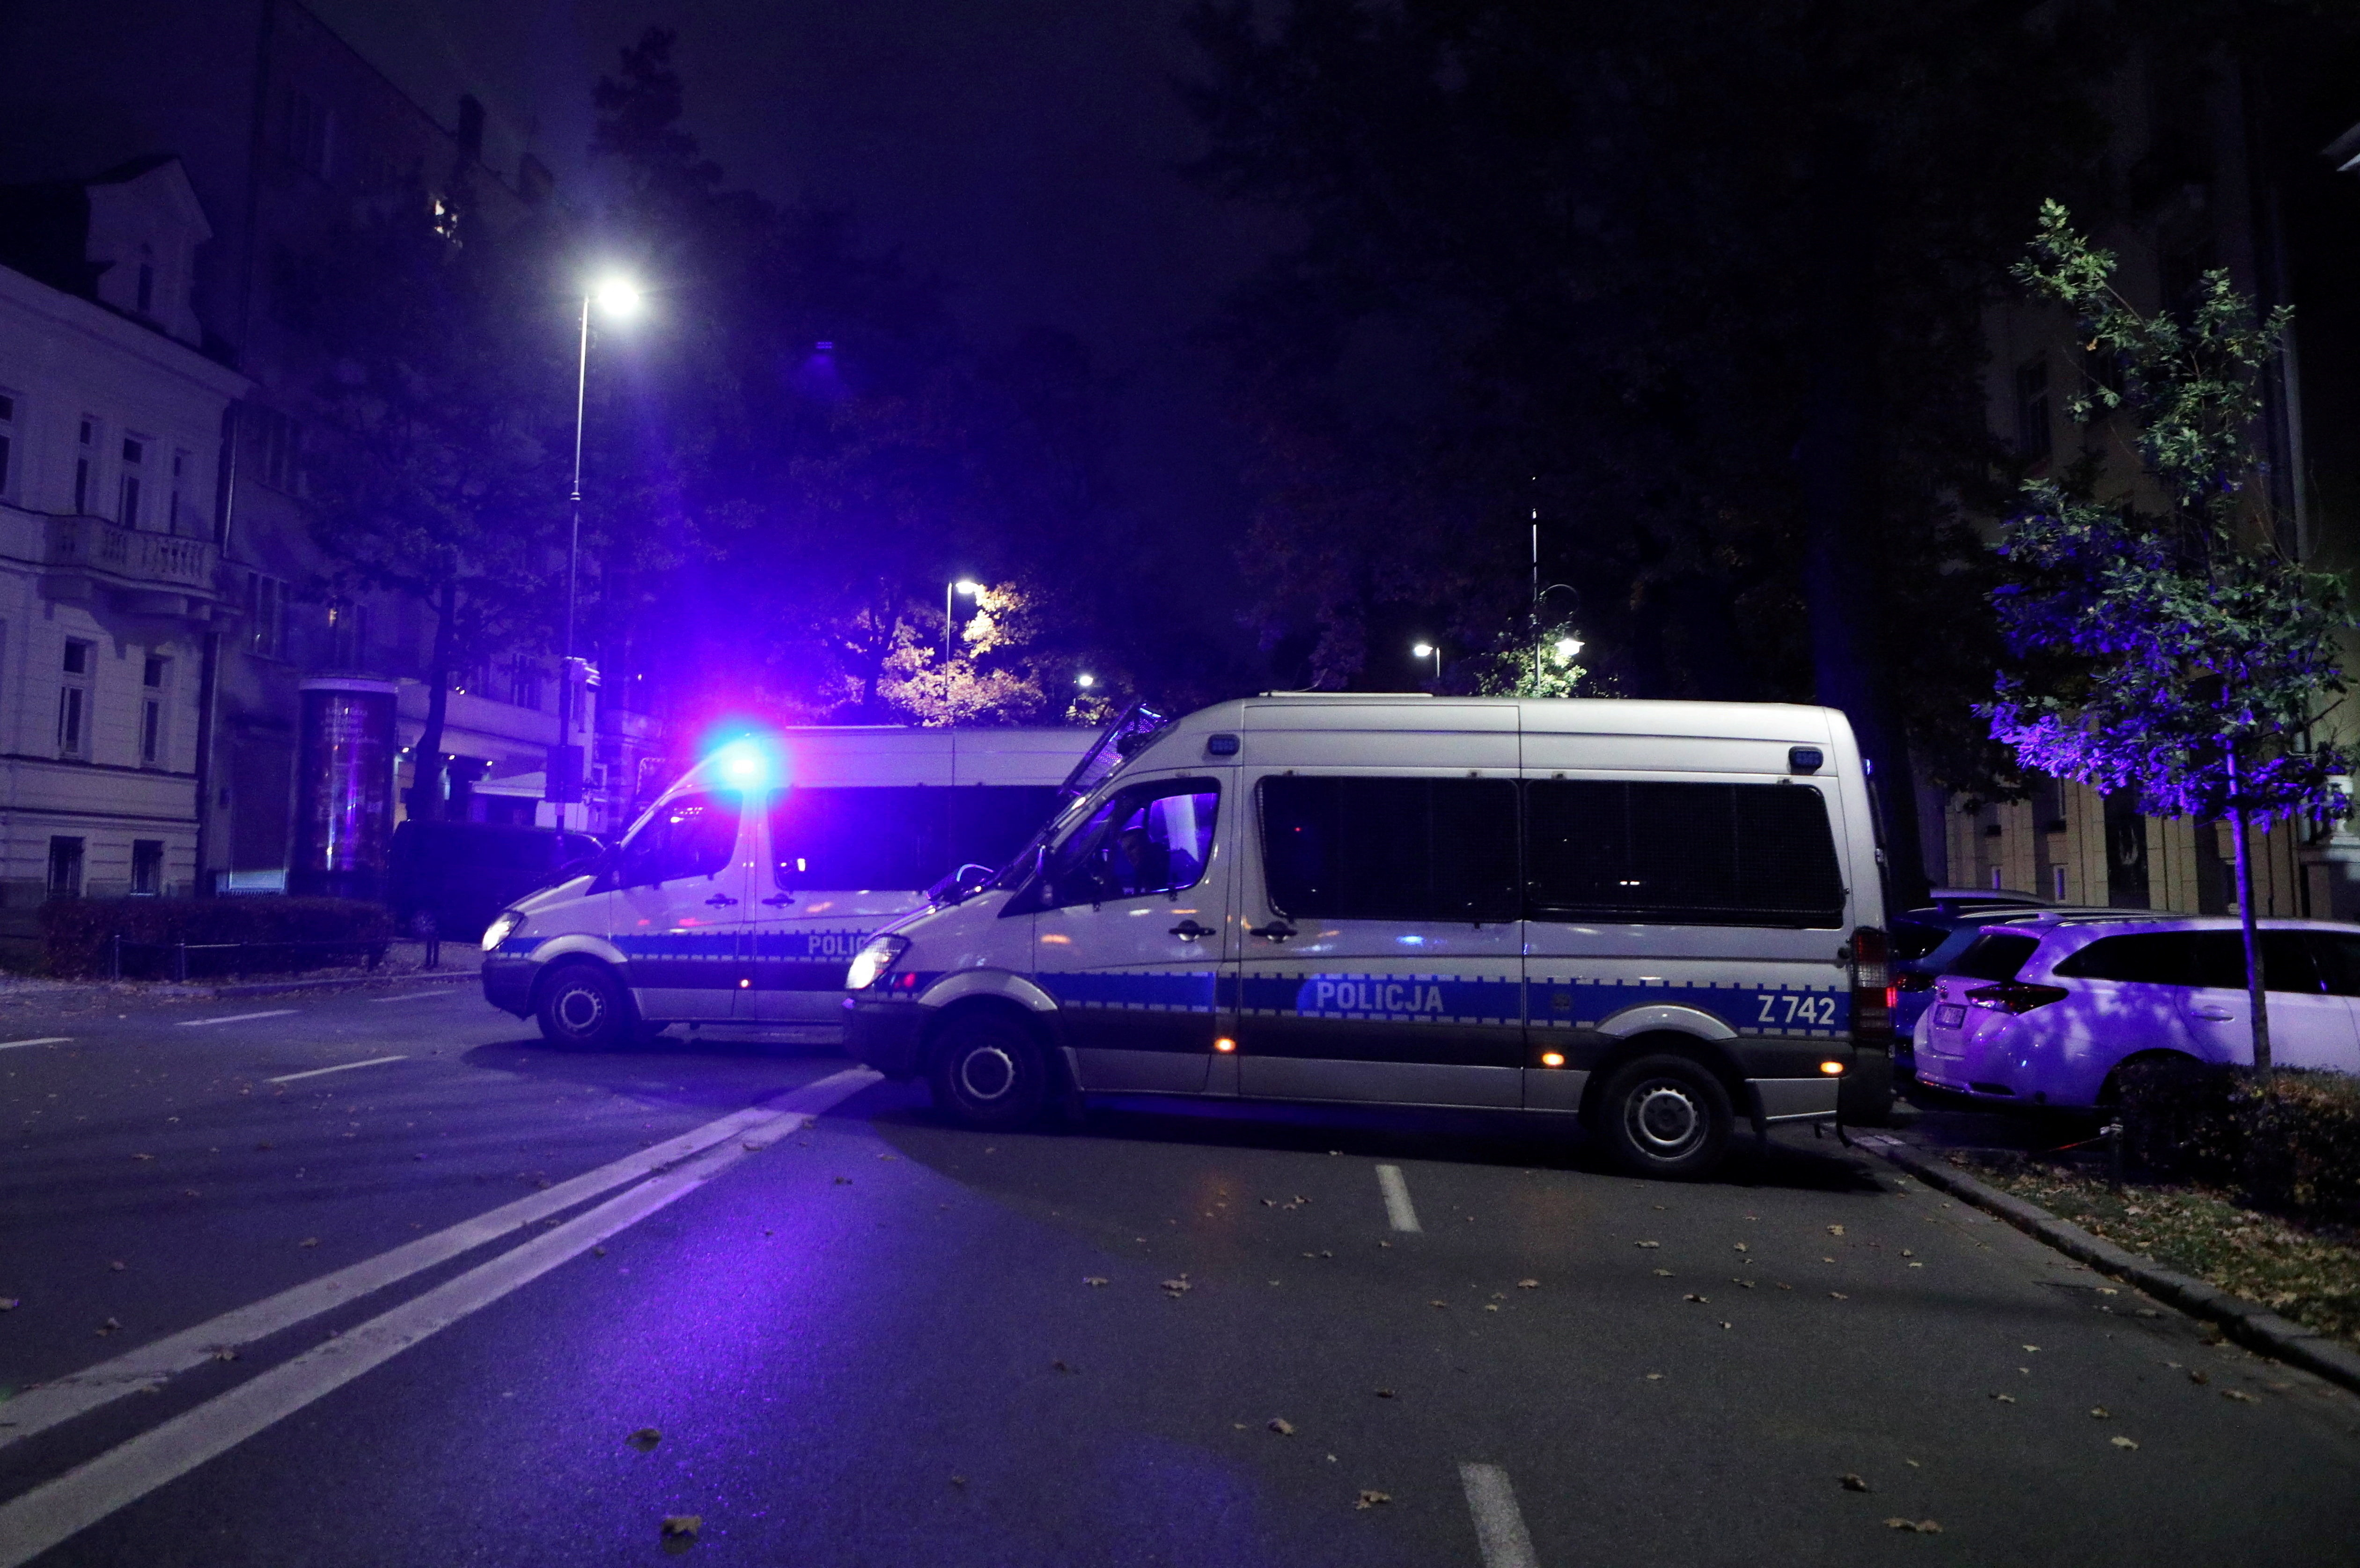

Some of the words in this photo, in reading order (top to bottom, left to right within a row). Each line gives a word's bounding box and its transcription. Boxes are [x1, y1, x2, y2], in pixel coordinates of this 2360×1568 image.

[1317, 982, 1444, 1012] POLICJA
[1758, 995, 1775, 1022] Z
[1782, 996, 1836, 1025] 742
